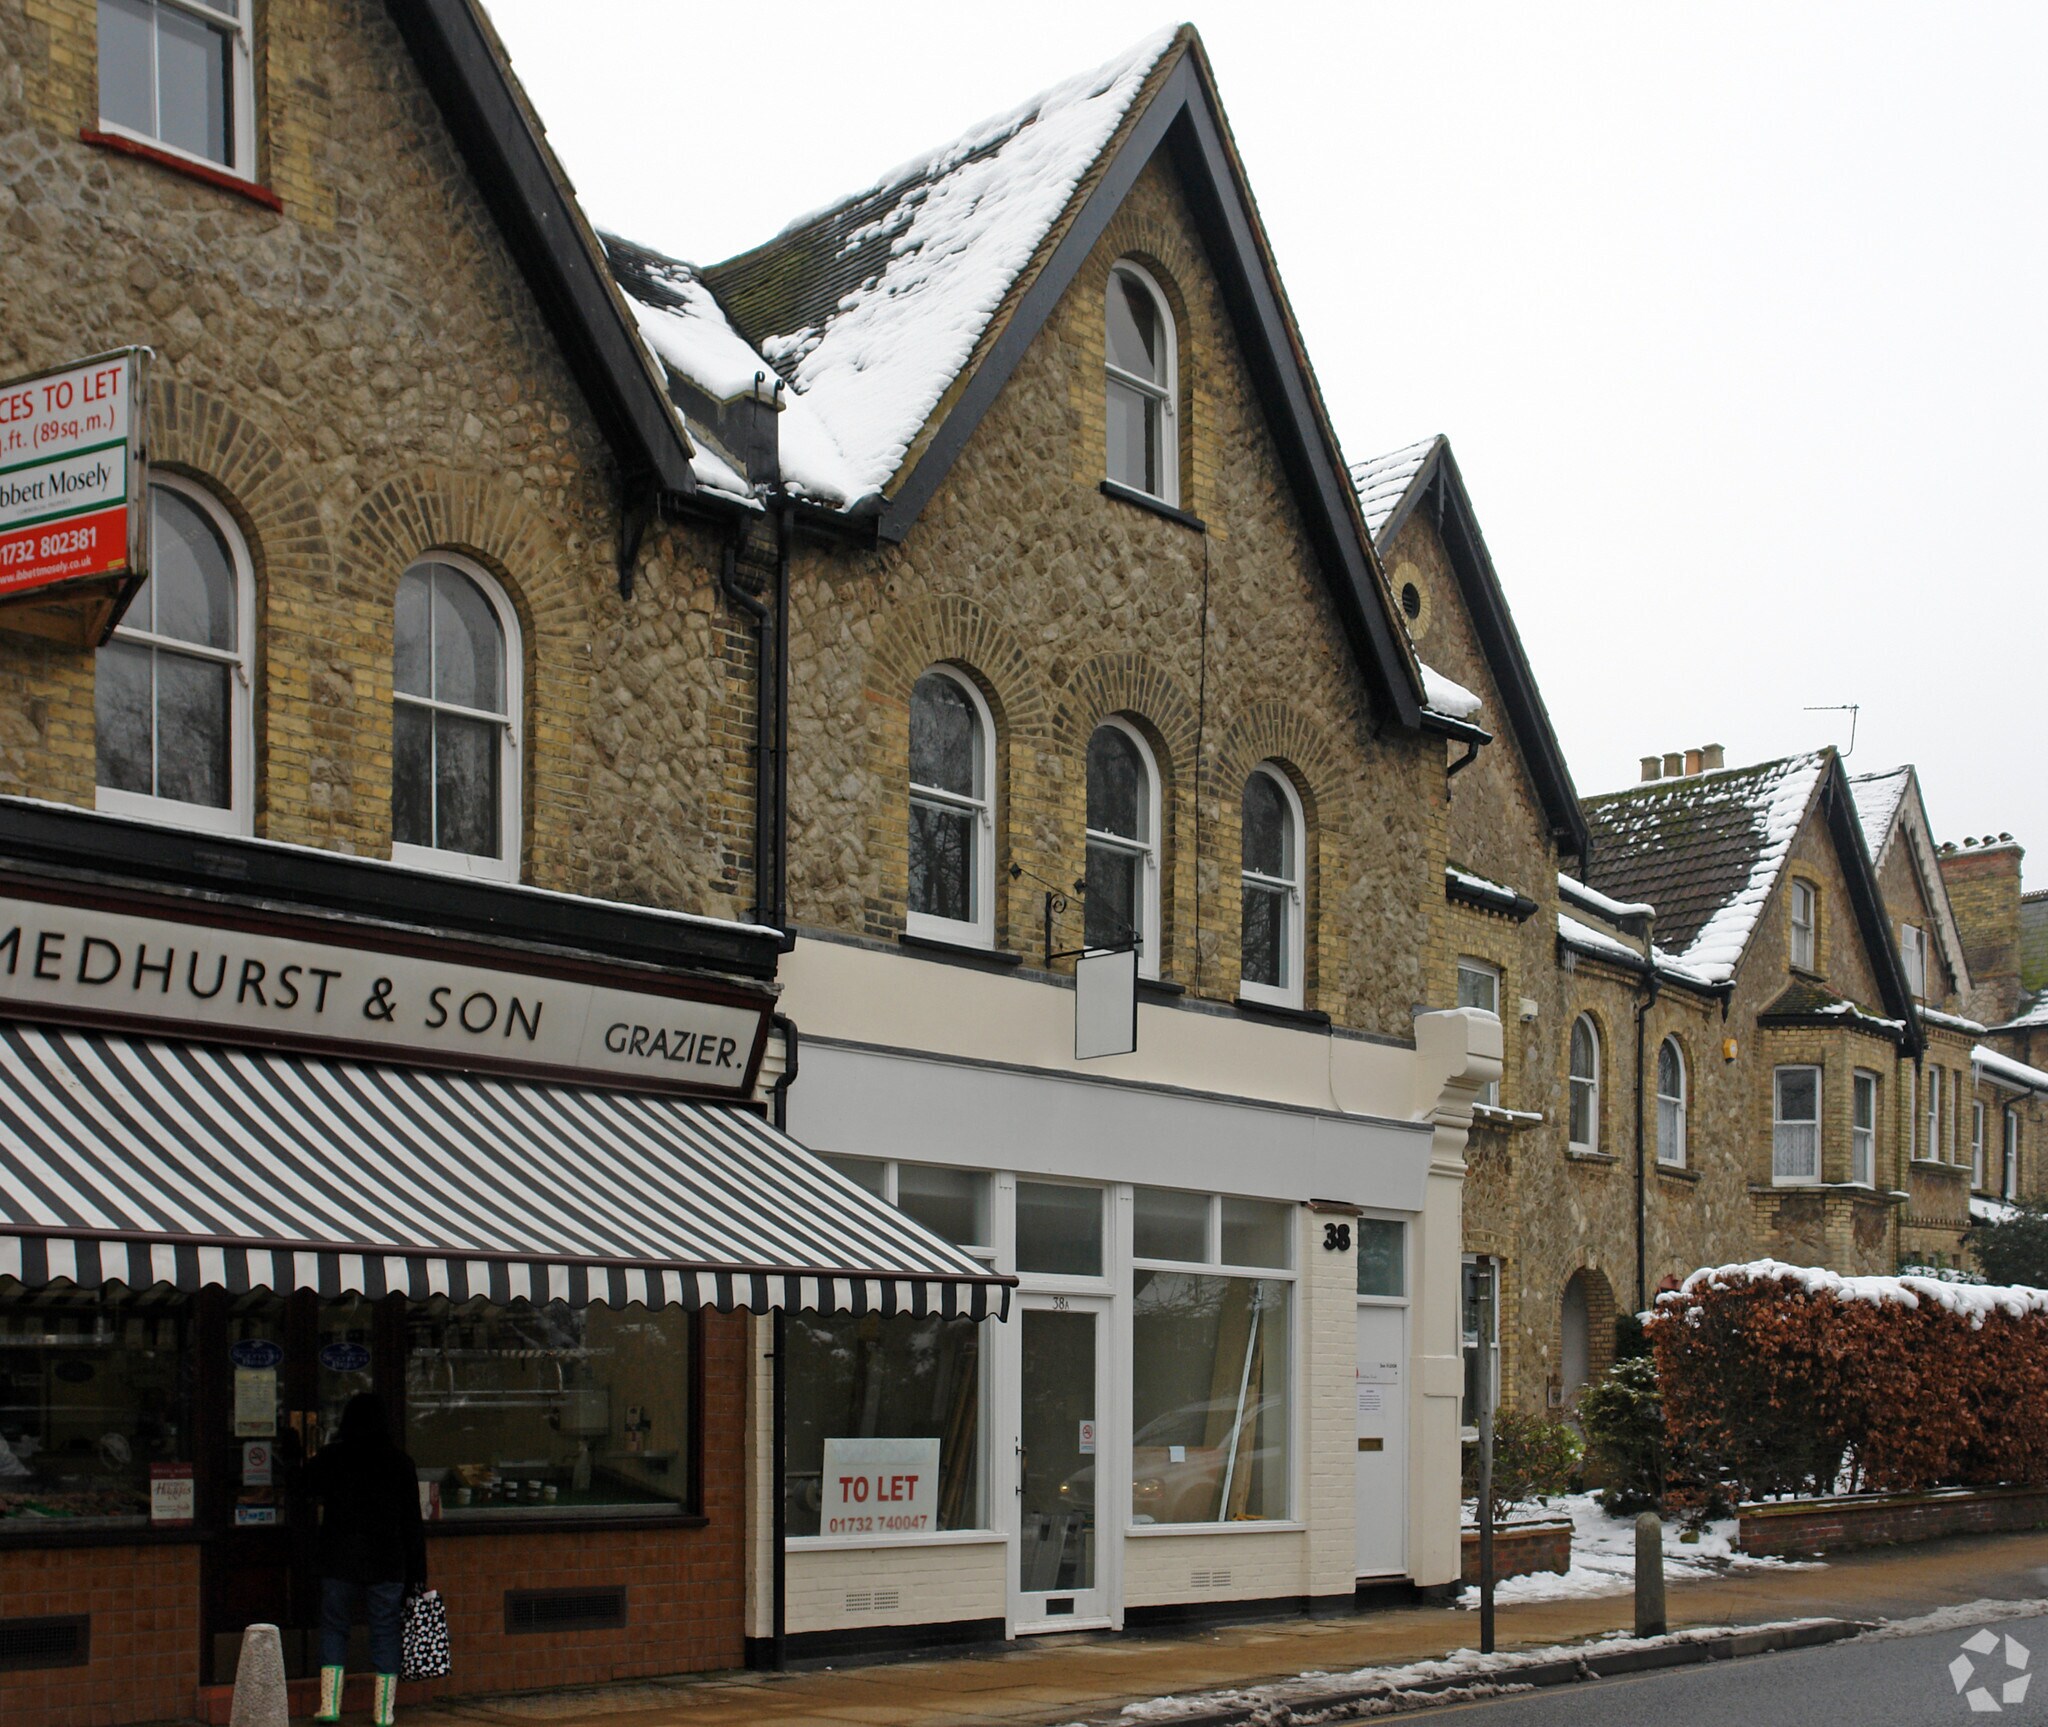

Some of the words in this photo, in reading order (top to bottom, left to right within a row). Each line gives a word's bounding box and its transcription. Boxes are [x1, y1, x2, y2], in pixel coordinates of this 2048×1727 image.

[42, 381, 73, 413] TO
[83, 367, 122, 402] LET
[0, 429, 27, 457] .ft.
[33, 404, 115, 449] (89sq.m.)
[0, 481, 44, 508] bbett
[48, 462, 111, 497] Mosely
[0, 539, 35, 566] 1732
[40, 526, 97, 558] 802381
[363, 977, 397, 1022] &
[425, 987, 543, 1041] SON
[604, 1022, 743, 1069] GRAZIER.
[1323, 1222, 1351, 1251] 38
[839, 1476, 869, 1503] TO
[877, 1475, 919, 1502] LET
[830, 1516, 873, 1533] 01732
[877, 1515, 928, 1530] 740047
